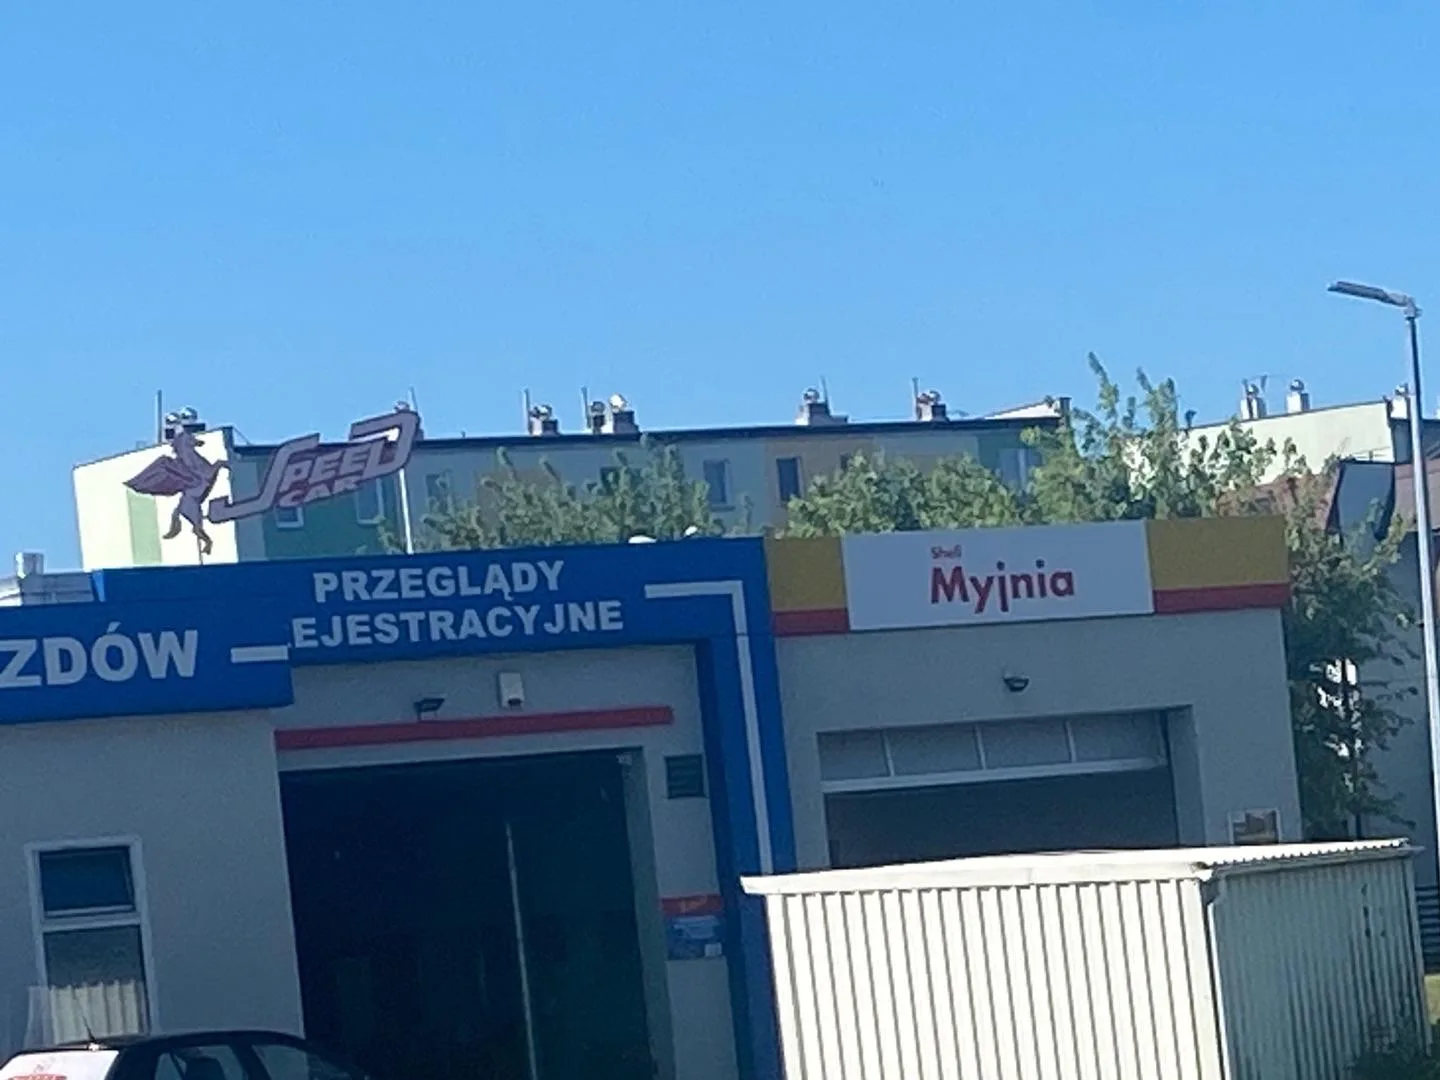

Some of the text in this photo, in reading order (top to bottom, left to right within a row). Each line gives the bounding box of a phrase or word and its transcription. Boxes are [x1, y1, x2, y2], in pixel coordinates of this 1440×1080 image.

[208, 411, 420, 523] SPEED
[313, 560, 565, 602] PRZEGLĄDY
[930, 558, 1076, 615] Myjnia
[289, 599, 625, 650] EJESTRACYJNE
